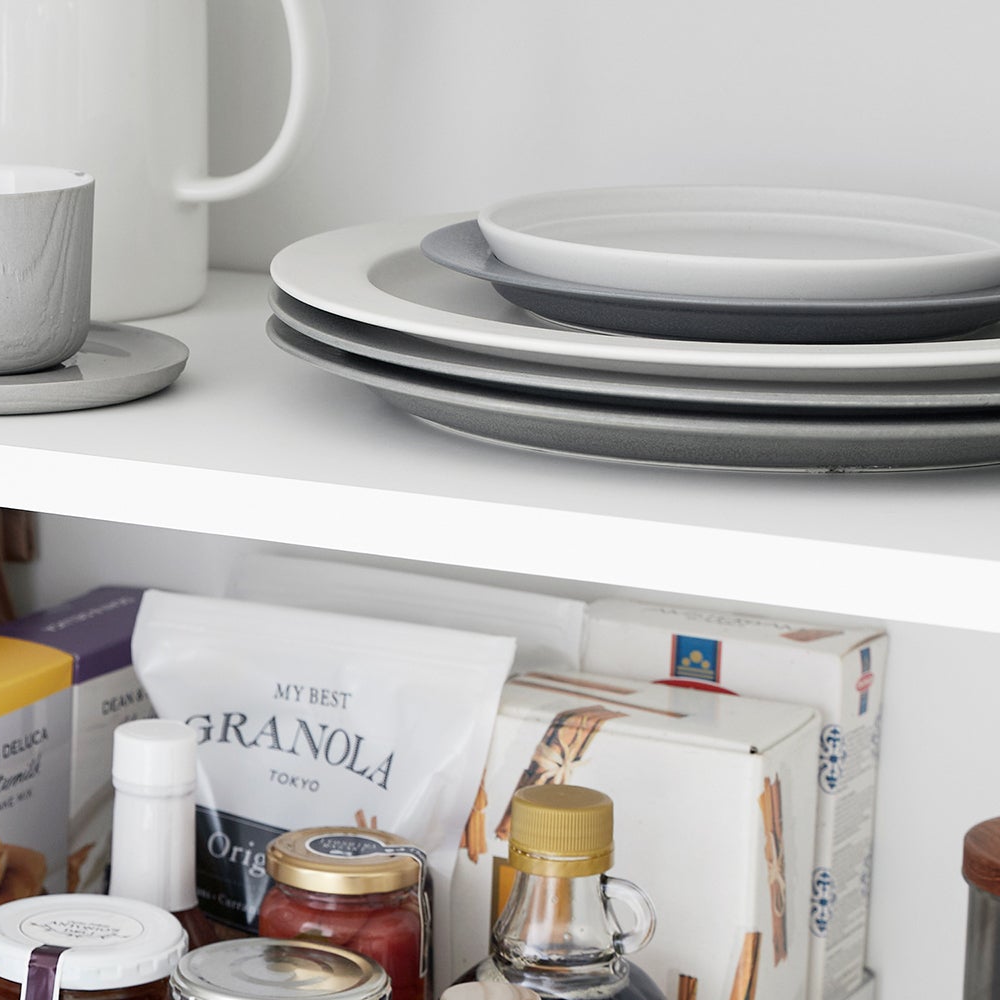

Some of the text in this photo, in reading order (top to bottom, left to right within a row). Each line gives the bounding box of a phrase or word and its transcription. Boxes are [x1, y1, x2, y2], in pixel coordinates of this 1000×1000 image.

[274, 683, 352, 709] MY BEST
[1, 727, 48, 759] DELUCA
[185, 711, 395, 790] GRANOLA
[269, 769, 320, 793] TOKYO
